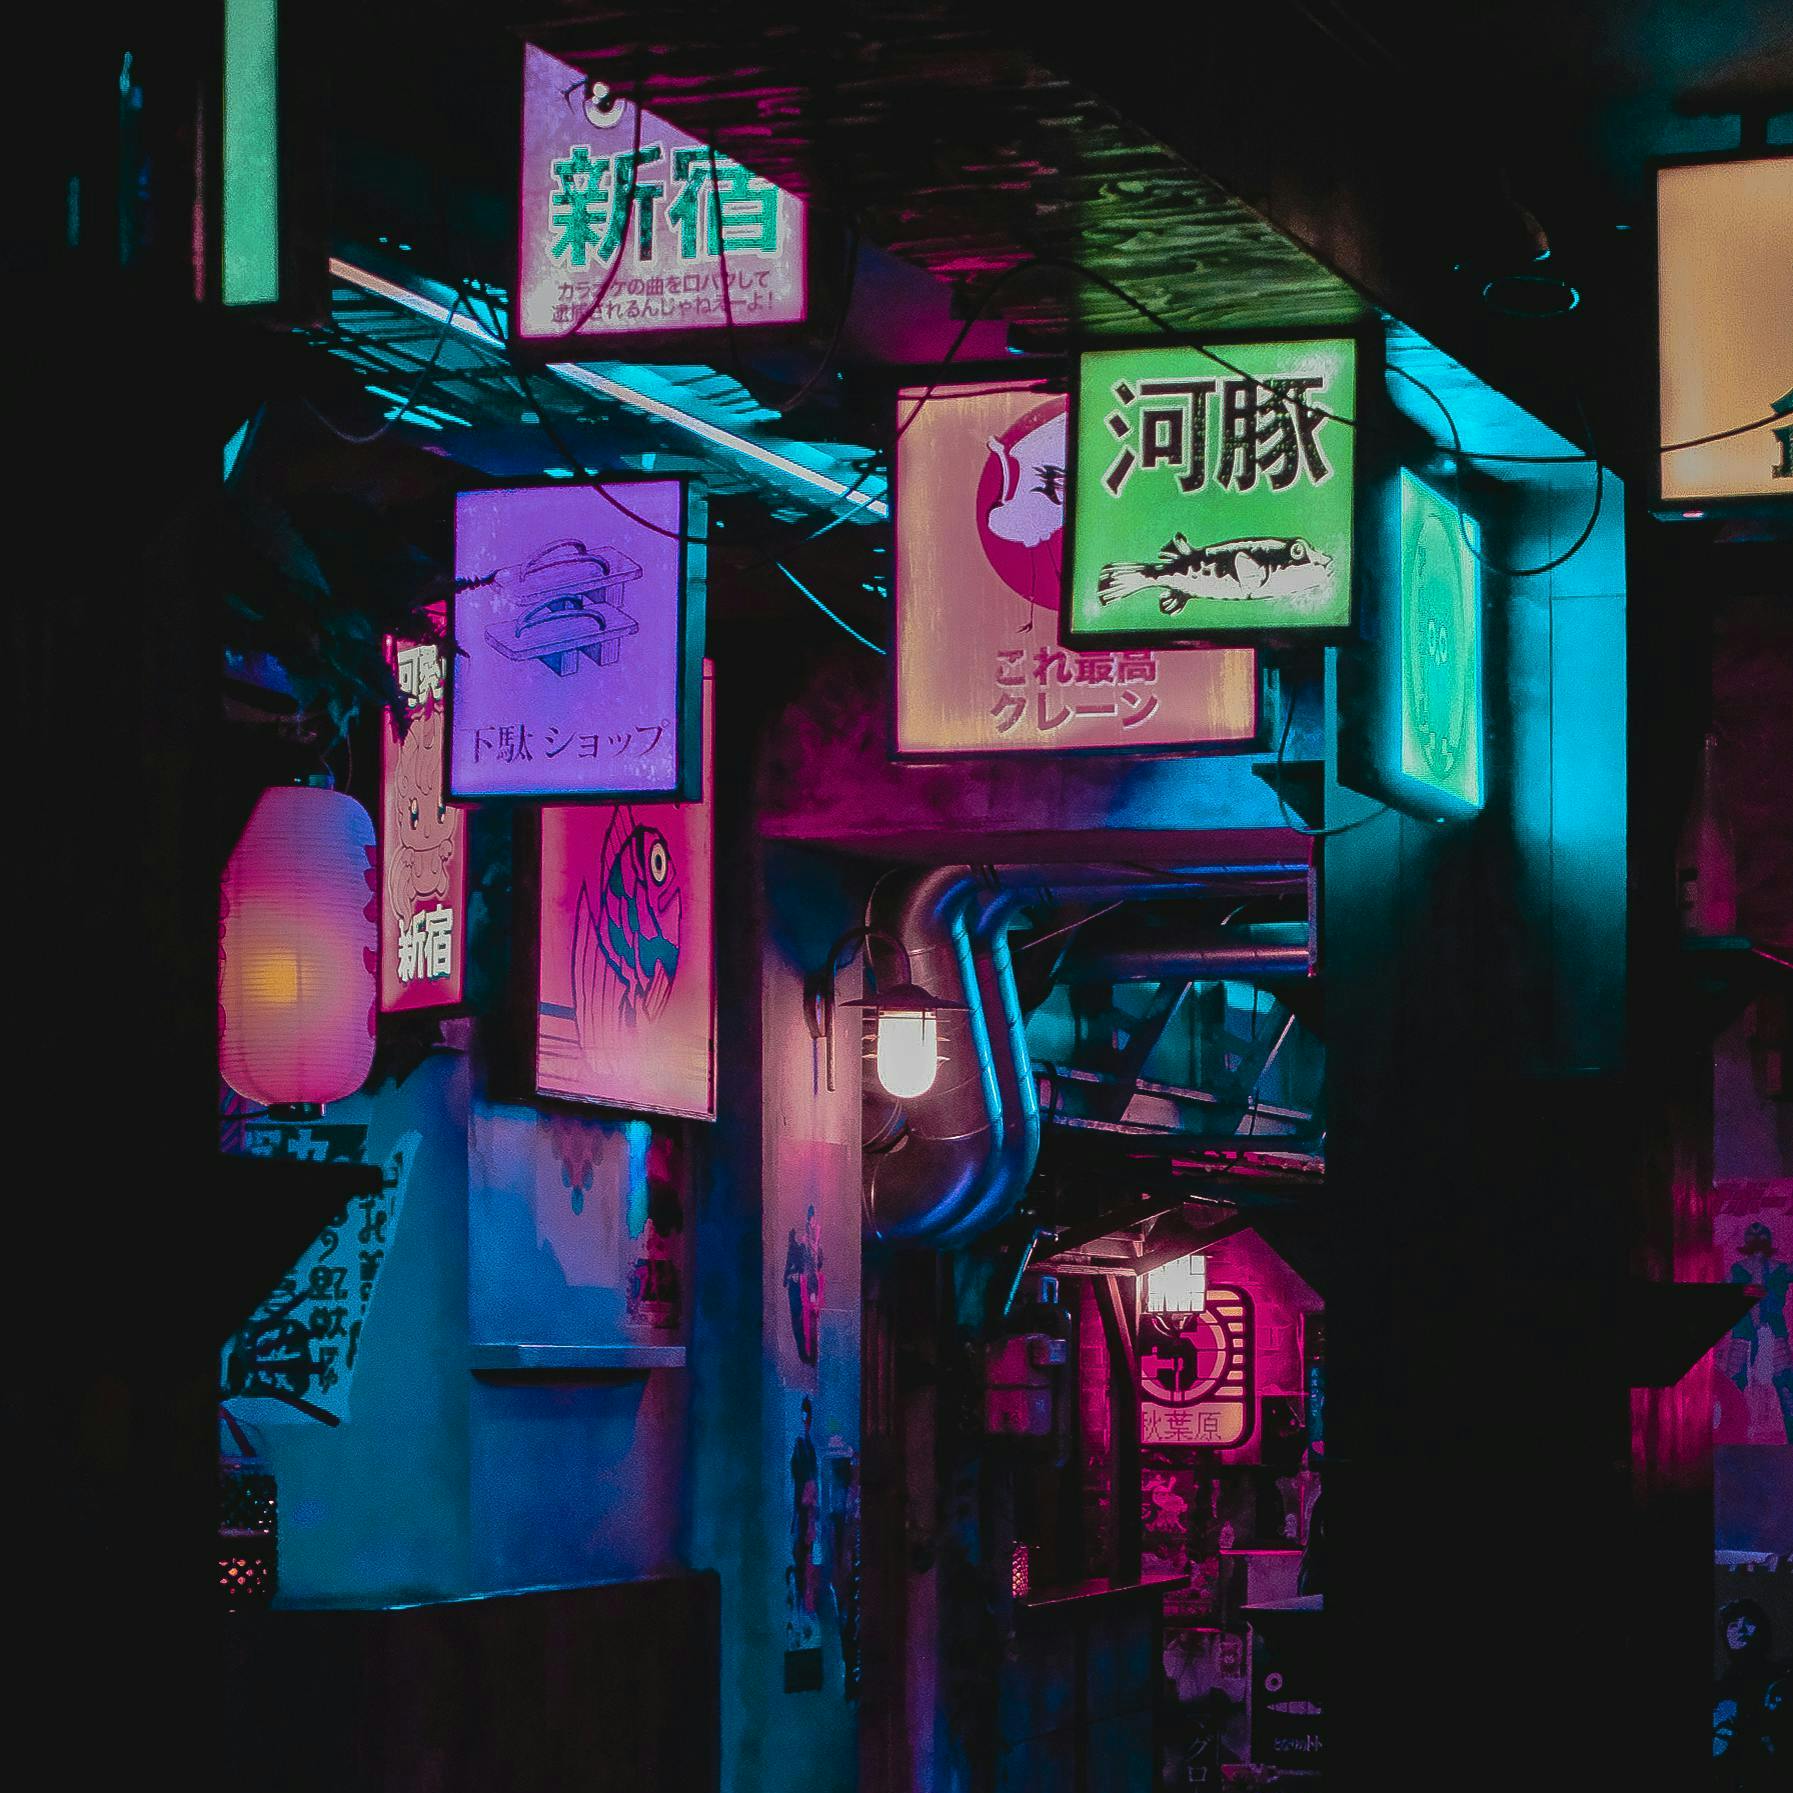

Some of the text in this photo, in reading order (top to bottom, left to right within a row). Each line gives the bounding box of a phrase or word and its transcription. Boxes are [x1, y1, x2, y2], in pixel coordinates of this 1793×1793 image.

[550, 143, 782, 270] 新宿
[1105, 375, 1331, 497] 河豚
[995, 647, 1159, 687] これ最高
[990, 690, 1160, 734] クレーン
[397, 903, 454, 983] 新宿
